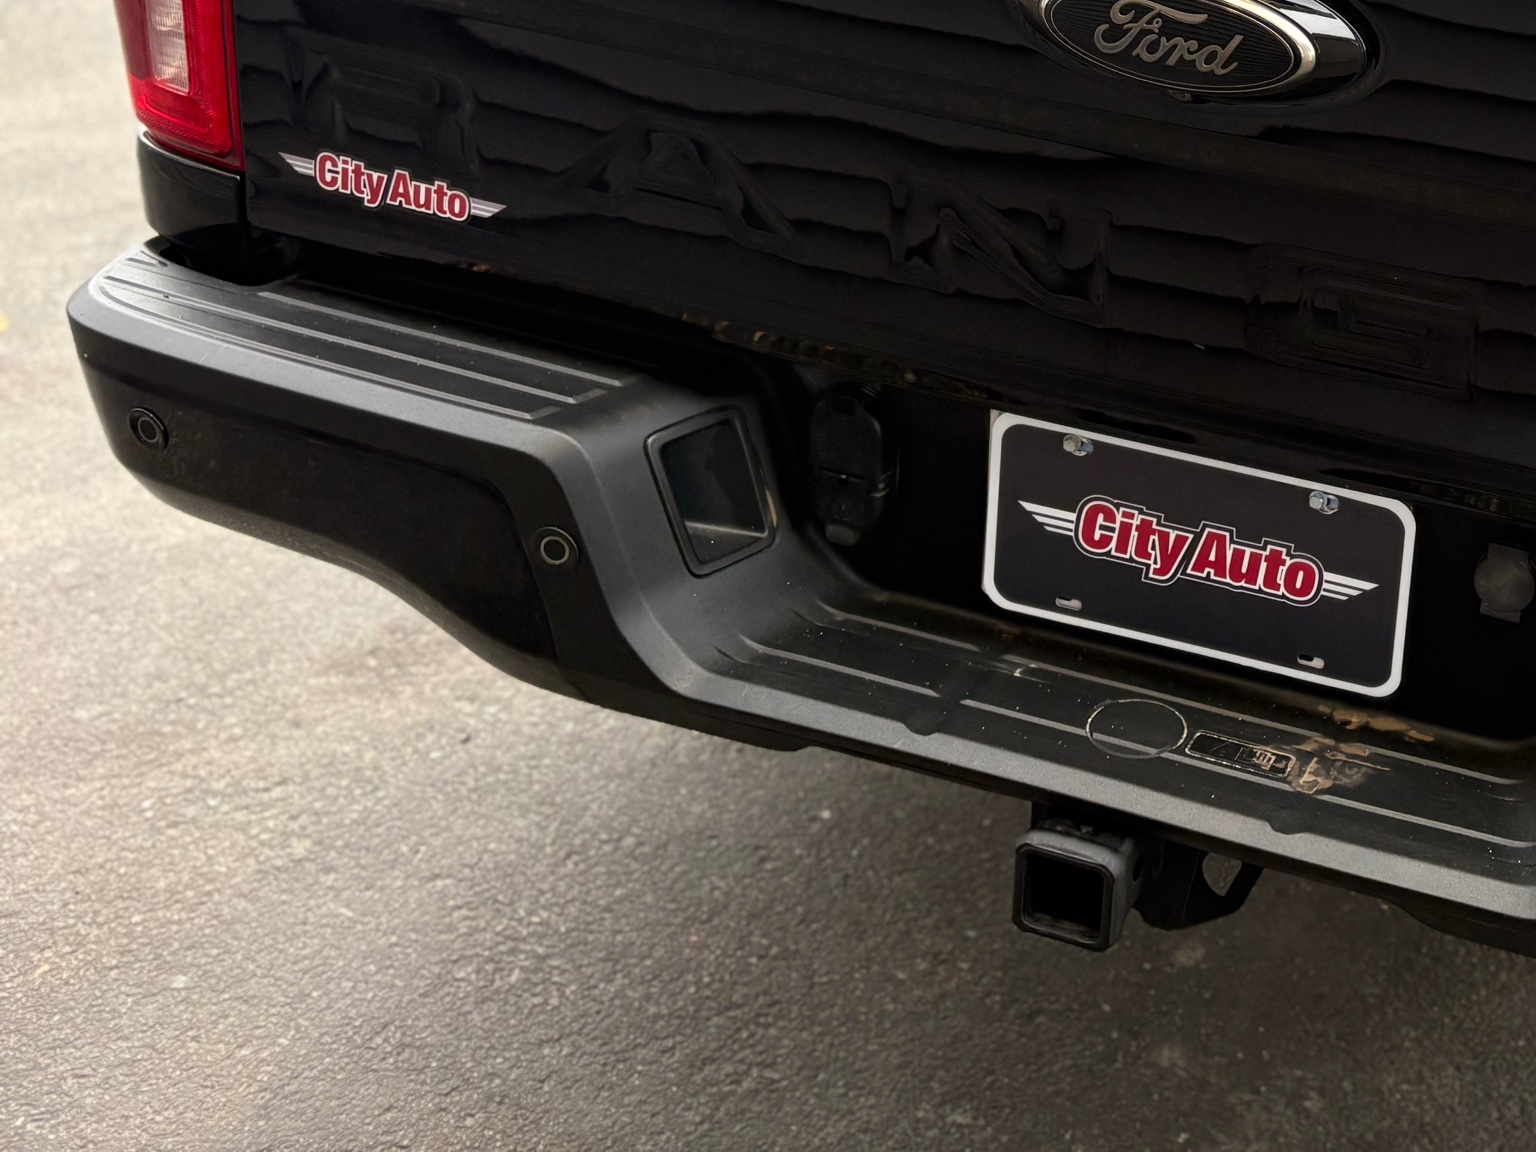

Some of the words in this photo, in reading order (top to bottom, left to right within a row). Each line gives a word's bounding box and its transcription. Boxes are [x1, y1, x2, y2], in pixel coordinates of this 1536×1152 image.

[316, 151, 388, 207] City
[386, 169, 472, 222] Auto
[1077, 499, 1194, 581] City
[1186, 526, 1324, 602] Auto
